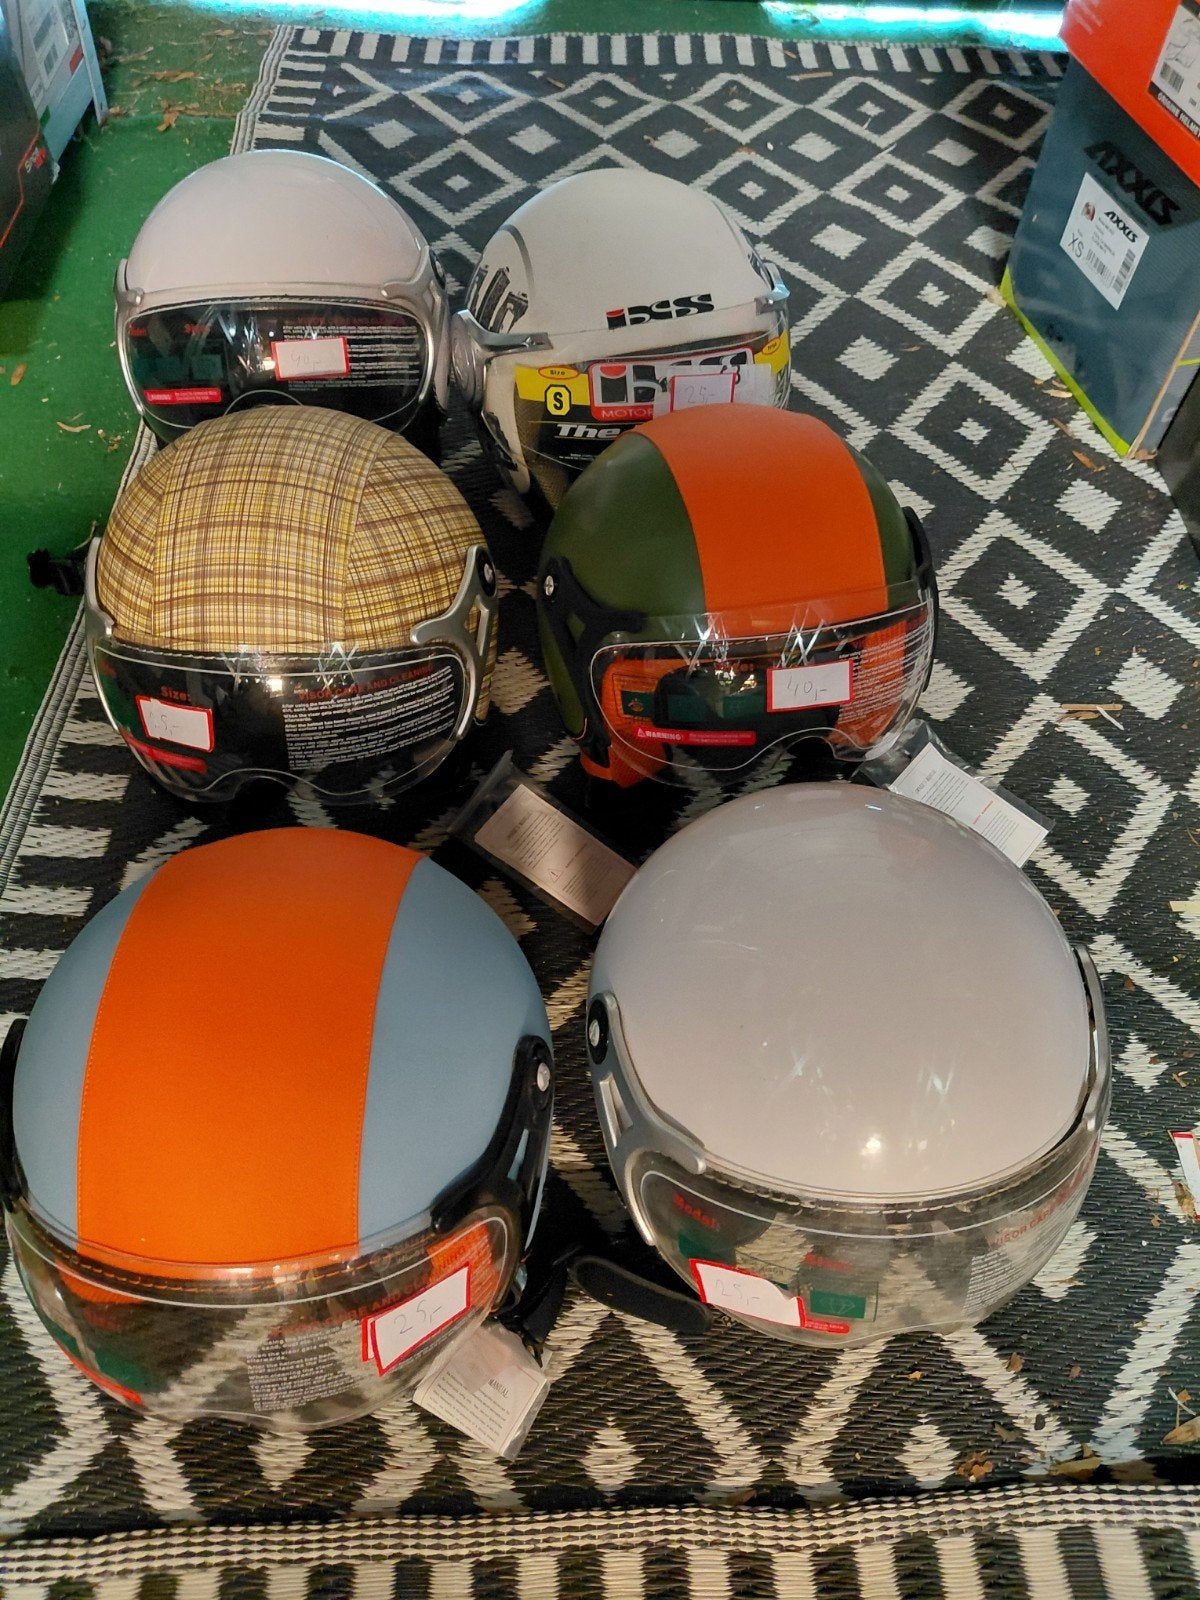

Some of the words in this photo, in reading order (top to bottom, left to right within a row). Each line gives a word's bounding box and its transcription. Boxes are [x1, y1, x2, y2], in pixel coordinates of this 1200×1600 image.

[1083, 140, 1181, 226] AXXIS
[1103, 210, 1138, 244] AXXIS
[1067, 232, 1085, 258] XS
[552, 391, 564, 411] S
[556, 424, 621, 439] The
[393, 1299, 443, 1335] 25,-
